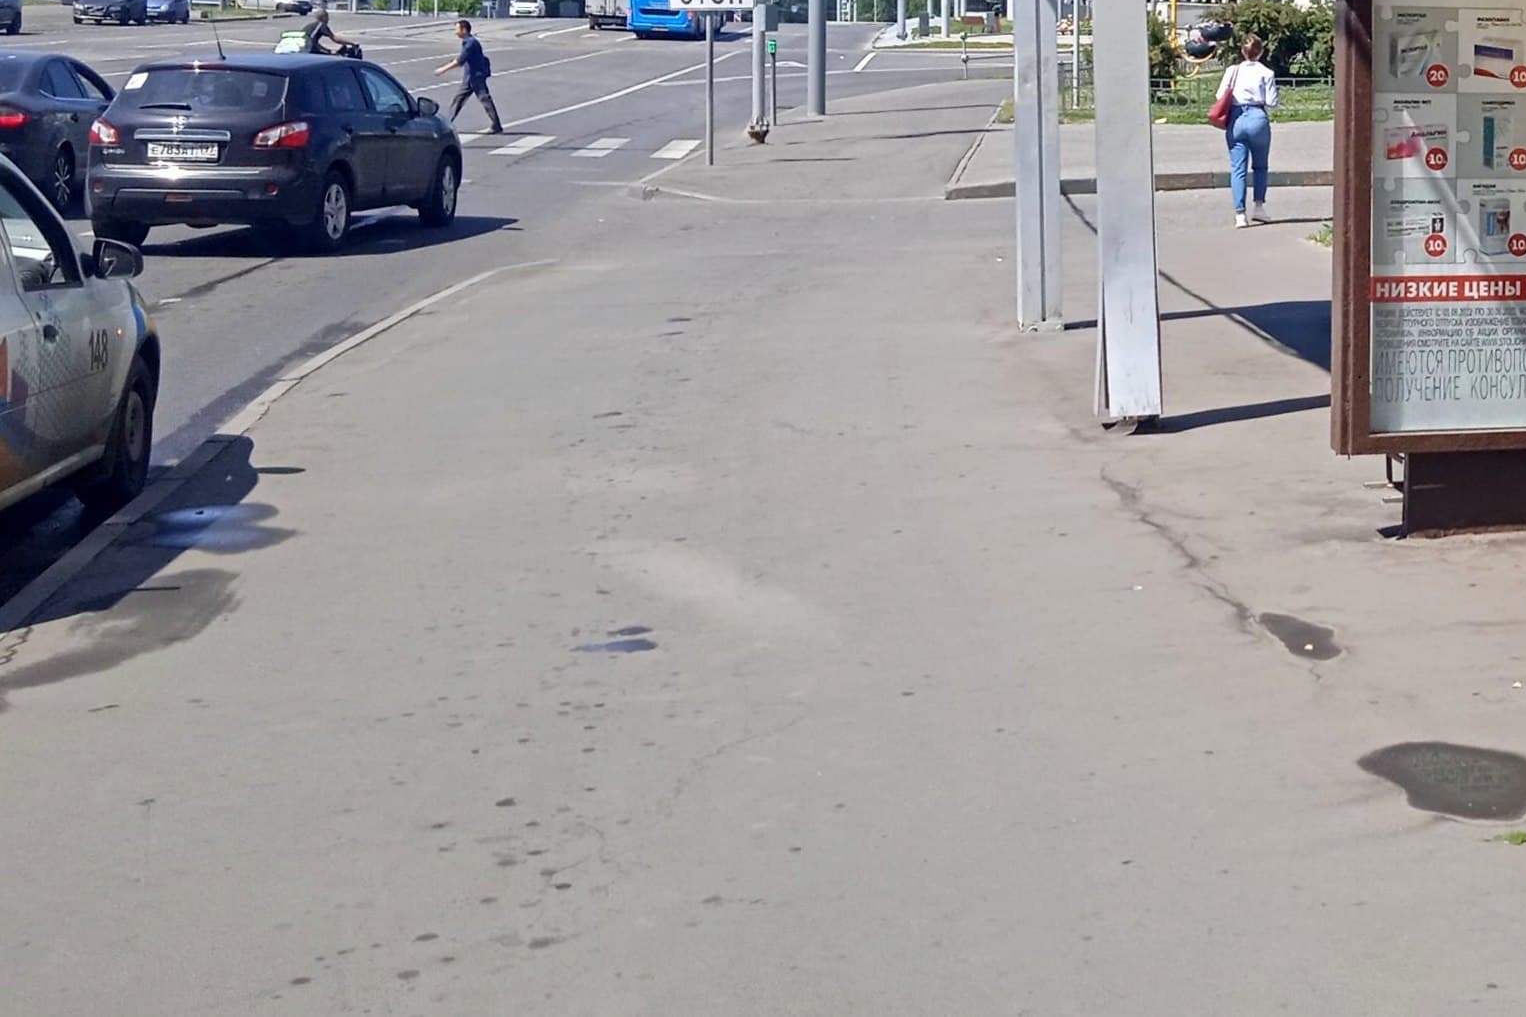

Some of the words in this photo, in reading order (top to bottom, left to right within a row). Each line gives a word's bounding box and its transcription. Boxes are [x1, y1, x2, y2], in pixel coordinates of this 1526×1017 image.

[1376, 281, 1458, 297] НИЗКИЕ
[1464, 281, 1521, 299] ЦЕНЫ
[88, 328, 109, 371] 148
[1375, 349, 1443, 375] ИМЕЮТСЯ
[1375, 375, 1461, 403] ПОЛУЧЕНИЕ
